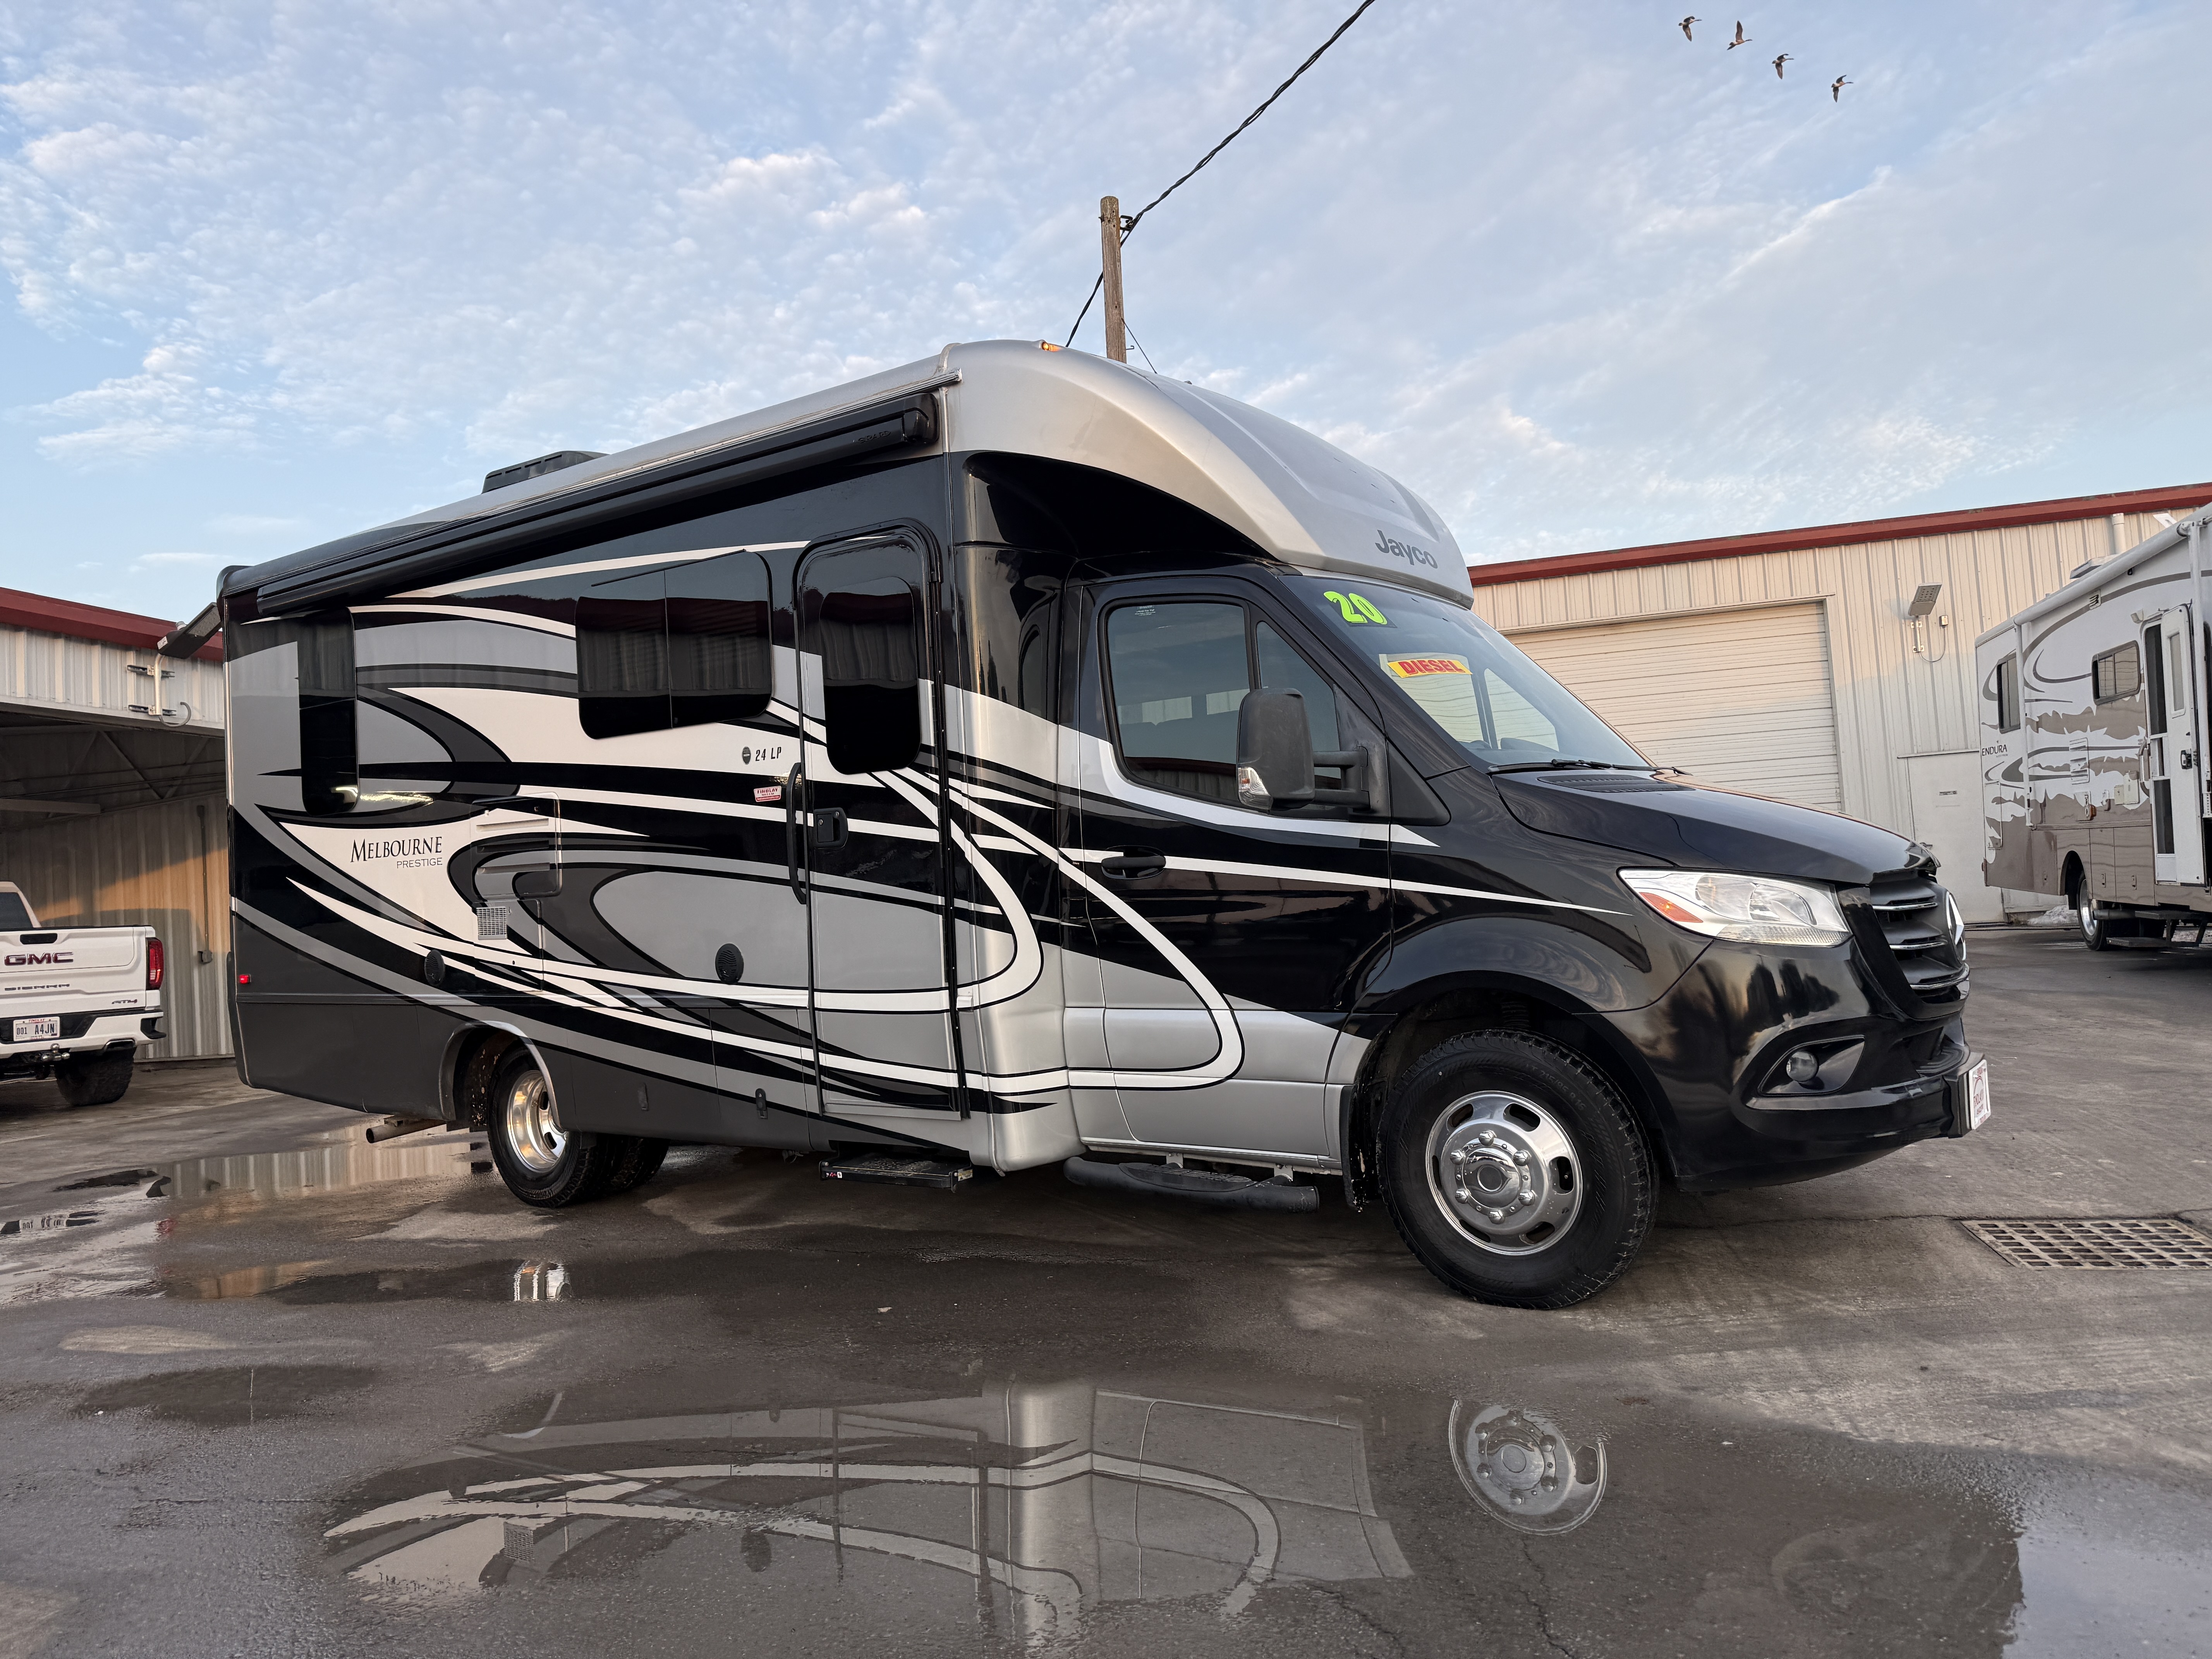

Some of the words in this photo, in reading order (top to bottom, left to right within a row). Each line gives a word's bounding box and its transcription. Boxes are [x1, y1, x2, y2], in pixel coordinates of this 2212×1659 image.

[1375, 529, 1438, 569] Jayco
[1323, 591, 1388, 625] 20
[1398, 659, 1466, 675] DIESEL
[755, 749, 766, 761] 24
[771, 747, 781, 759] LP
[1982, 744, 2007, 756] ENDURA
[350, 836, 442, 863] MELBOURNE
[397, 857, 443, 869] PRESTIGE
[4, 951, 74, 966] GMC
[17, 1027, 27, 1035] 001
[35, 1023, 55, 1035] A4JN
